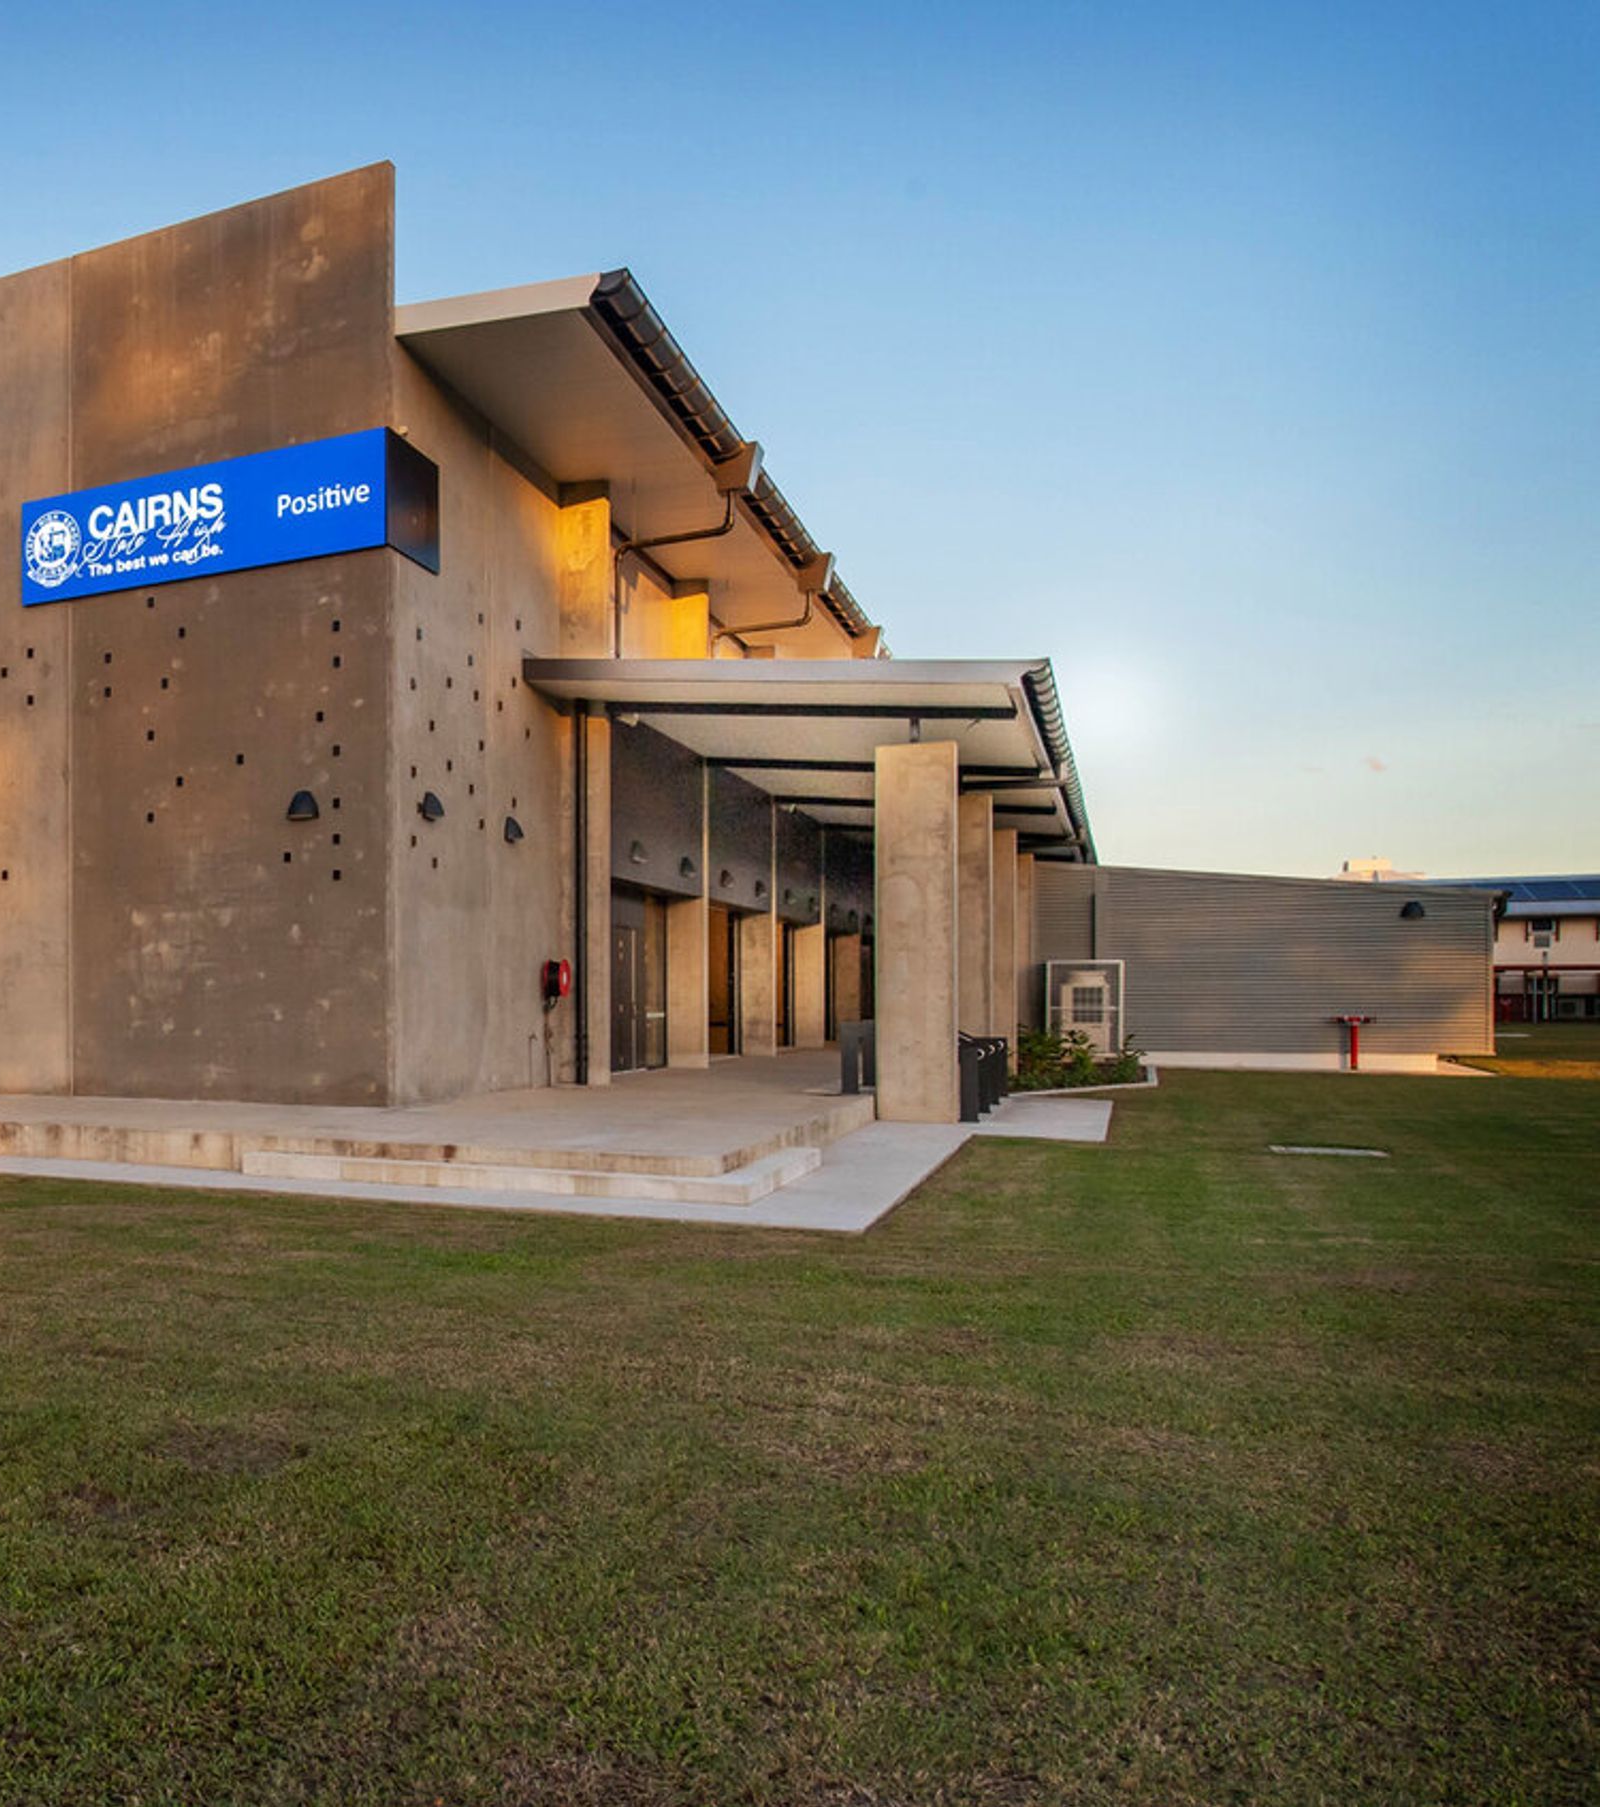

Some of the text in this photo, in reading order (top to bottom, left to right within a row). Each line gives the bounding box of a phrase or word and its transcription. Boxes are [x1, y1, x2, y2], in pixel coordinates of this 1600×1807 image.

[88, 483, 223, 540] CAIRNS
[277, 483, 370, 518] Positive
[88, 563, 113, 577] The
[116, 556, 146, 573] best
[149, 553, 169, 566] we
[172, 548, 198, 562] can
